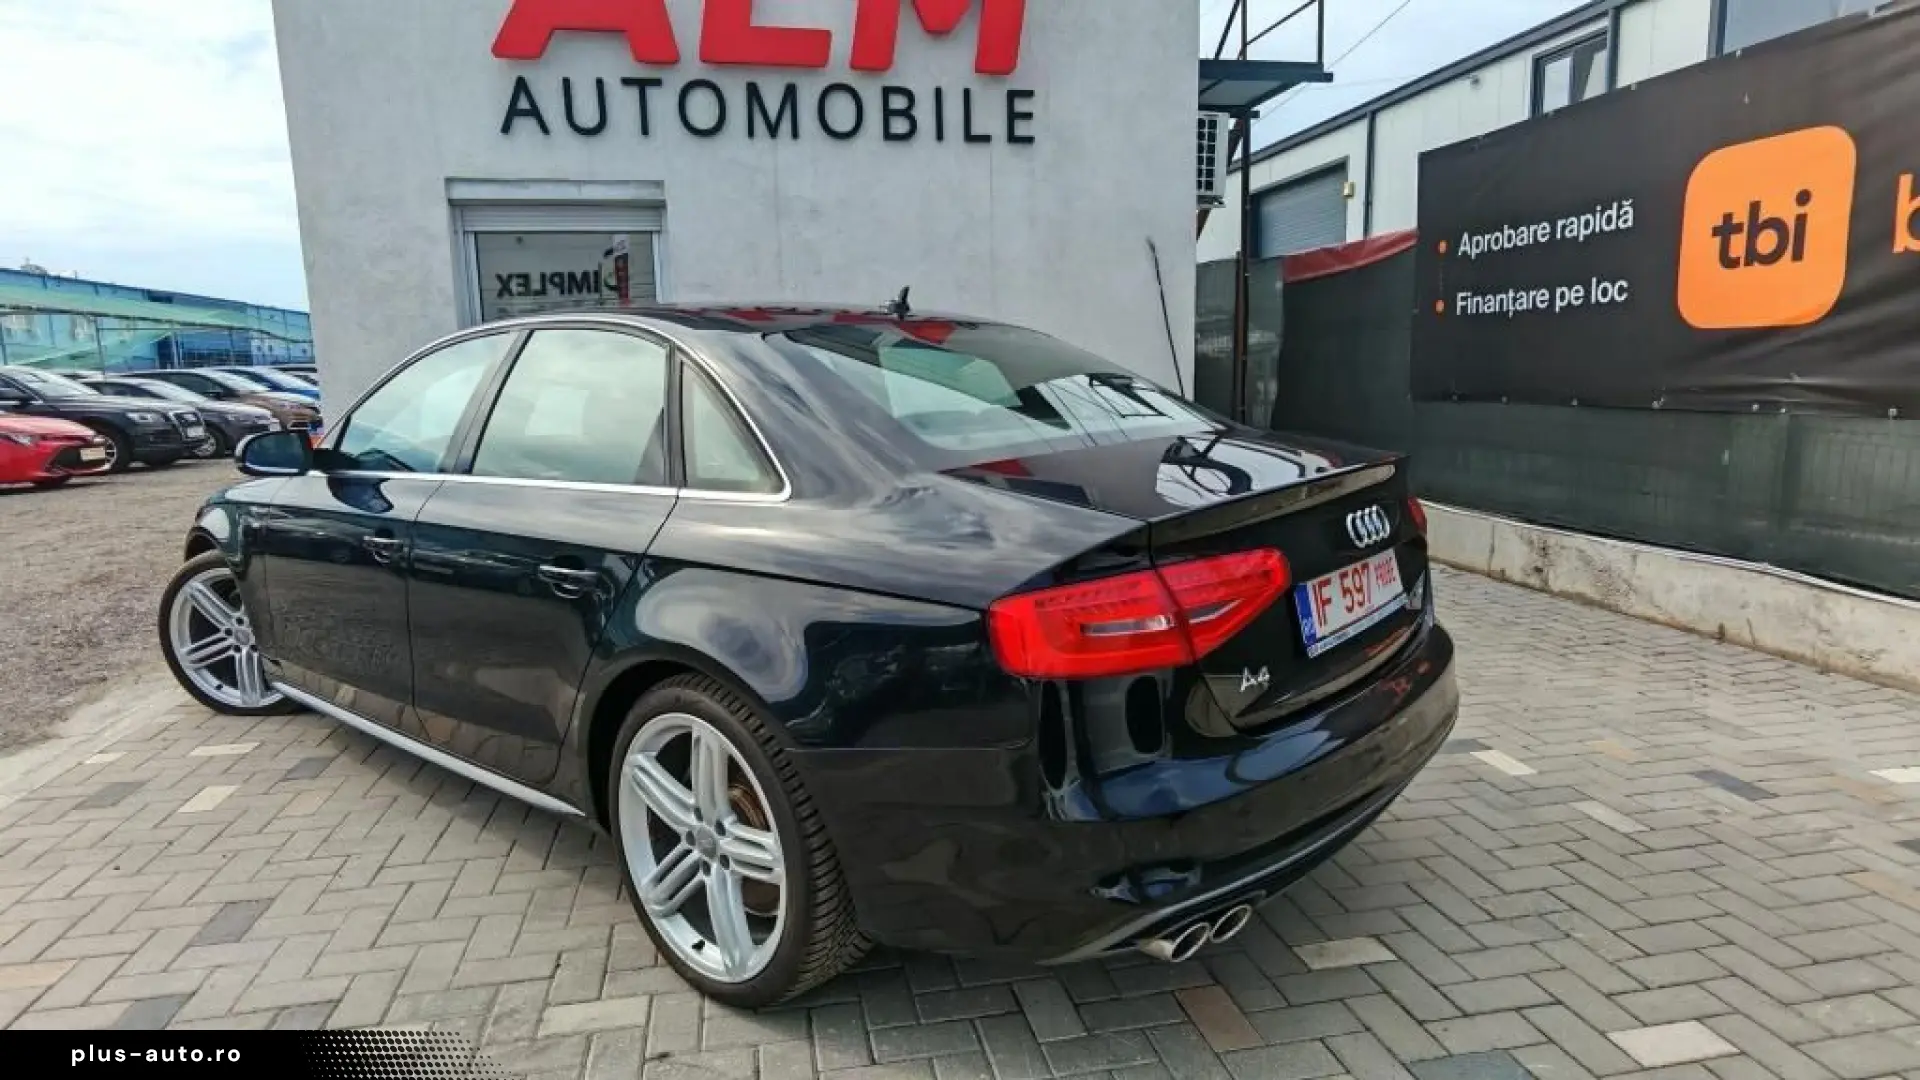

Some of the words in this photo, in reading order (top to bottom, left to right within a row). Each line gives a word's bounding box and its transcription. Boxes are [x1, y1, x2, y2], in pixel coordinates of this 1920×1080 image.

[500, 76, 1036, 145] AUTOMOBILE
[1457, 221, 1550, 260] Aprobare
[1555, 198, 1634, 243] rapidă
[1711, 188, 1812, 270] tbi
[1456, 288, 1550, 318] Finanțare
[1555, 283, 1585, 313] pe
[1591, 276, 1629, 305] loc
[1312, 577, 1333, 629] IF
[1338, 562, 1372, 614] 597
[1240, 665, 1270, 692] A4
